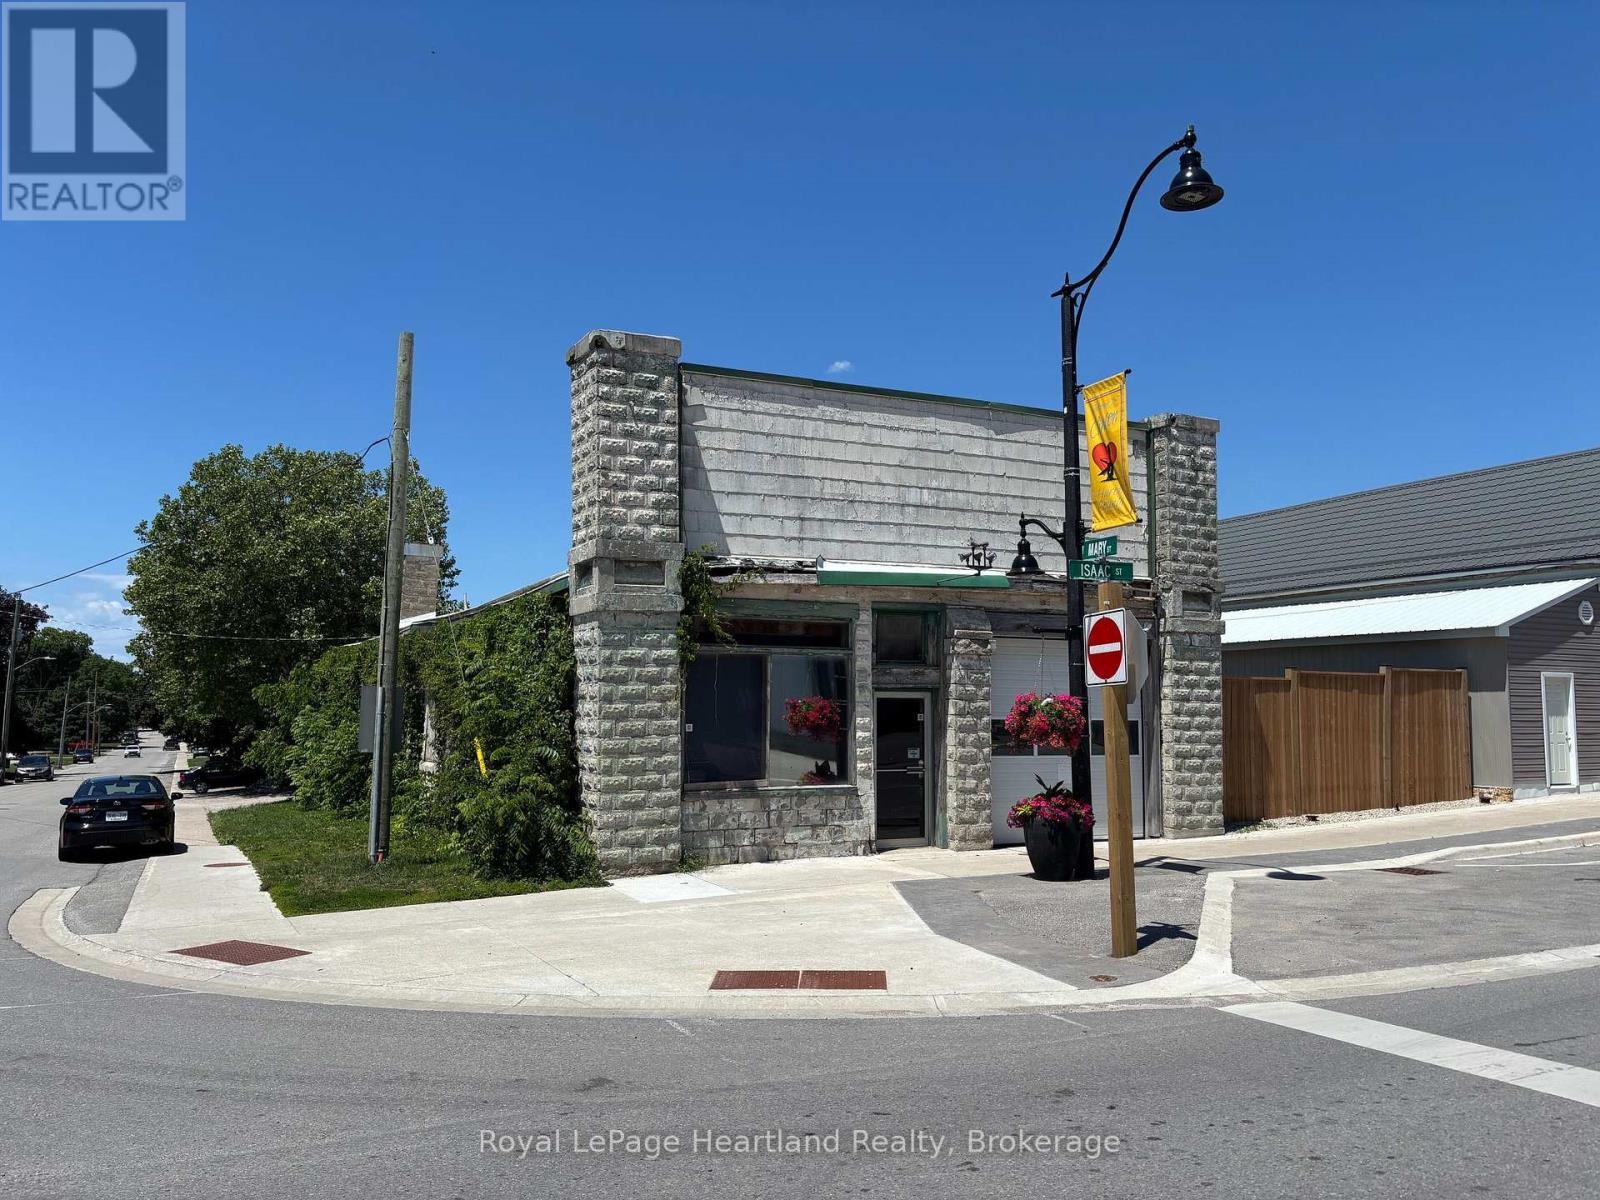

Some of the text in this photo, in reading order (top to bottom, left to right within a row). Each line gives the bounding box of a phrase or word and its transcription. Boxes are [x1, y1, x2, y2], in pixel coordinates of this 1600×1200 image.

[1088, 541, 1112, 556] MARY ST
[1080, 563, 1122, 577] ISAAC ST
